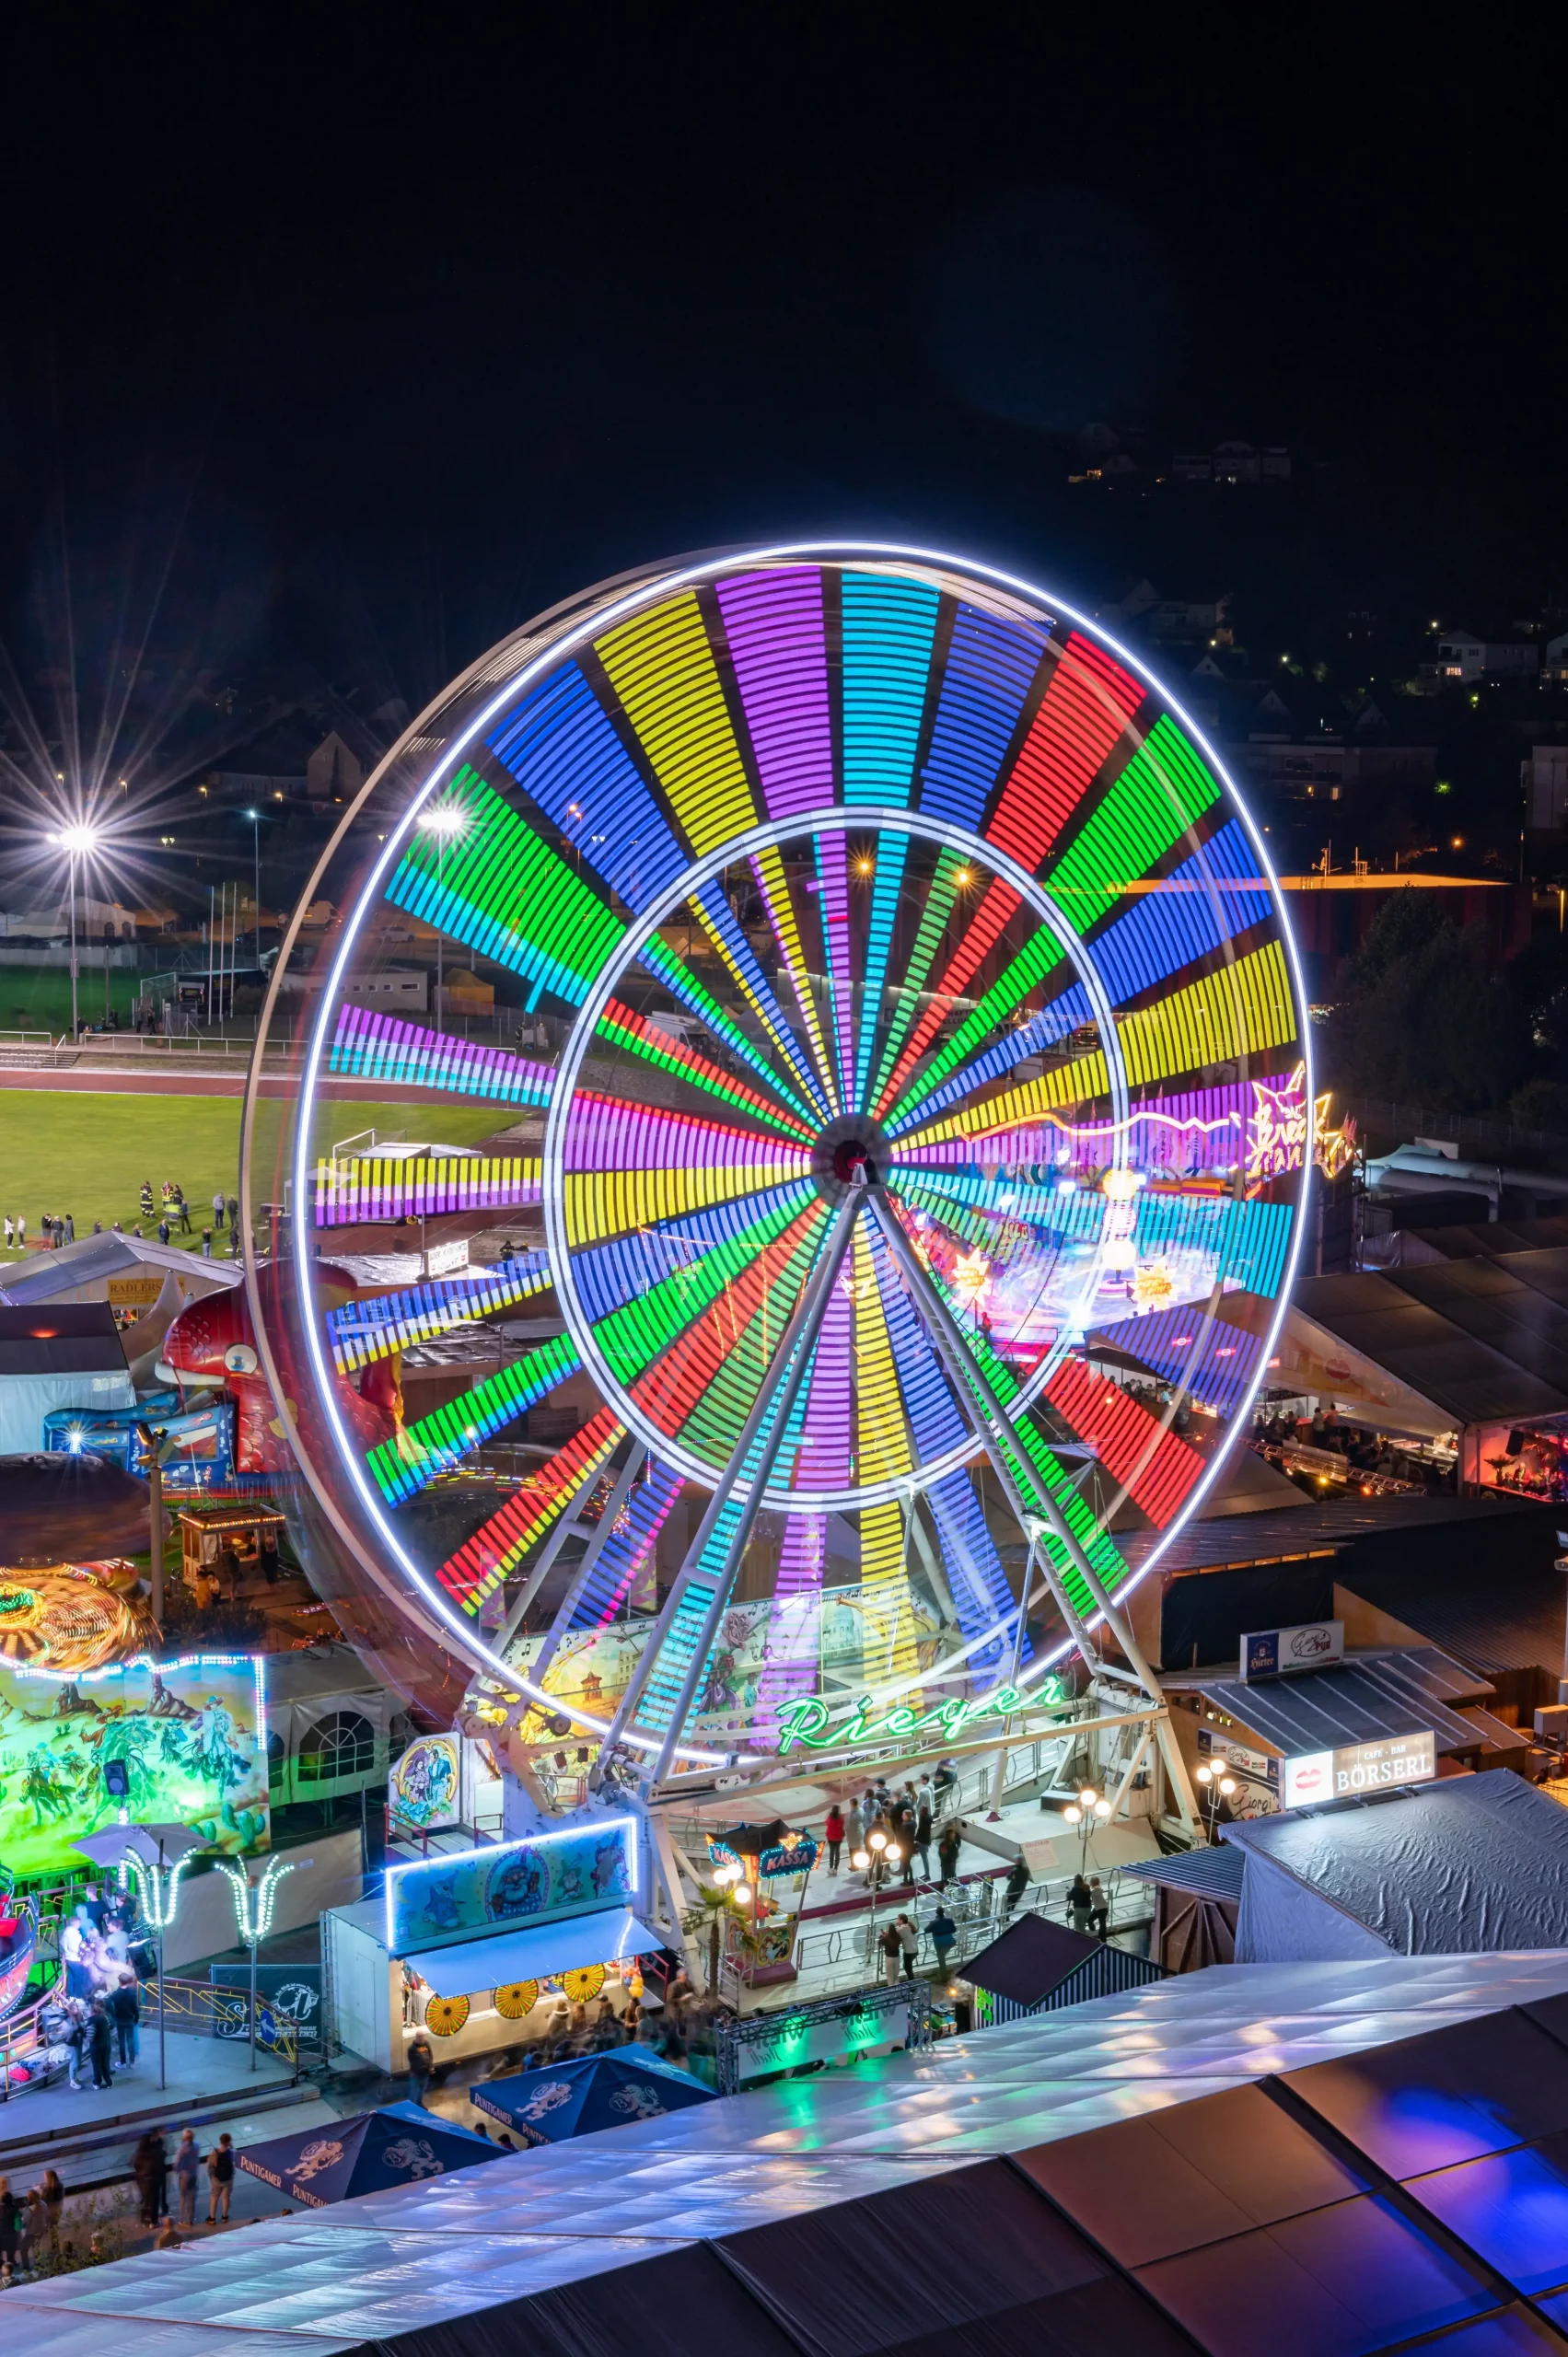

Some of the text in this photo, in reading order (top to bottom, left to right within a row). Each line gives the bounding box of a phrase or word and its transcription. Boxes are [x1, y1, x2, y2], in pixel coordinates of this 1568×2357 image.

[1316, 1642, 1331, 1651] PUB
[1250, 1657, 1274, 1670] Hirter
[774, 1676, 1063, 1756] Rieger
[1391, 1745, 1407, 1754] BAR
[1336, 1754, 1432, 1792] BÖRSERL
[767, 1851, 808, 1871] KASSA
[474, 2093, 513, 2126] PUNTIGAMER
[240, 2155, 282, 2189] PUNTIGAMER
